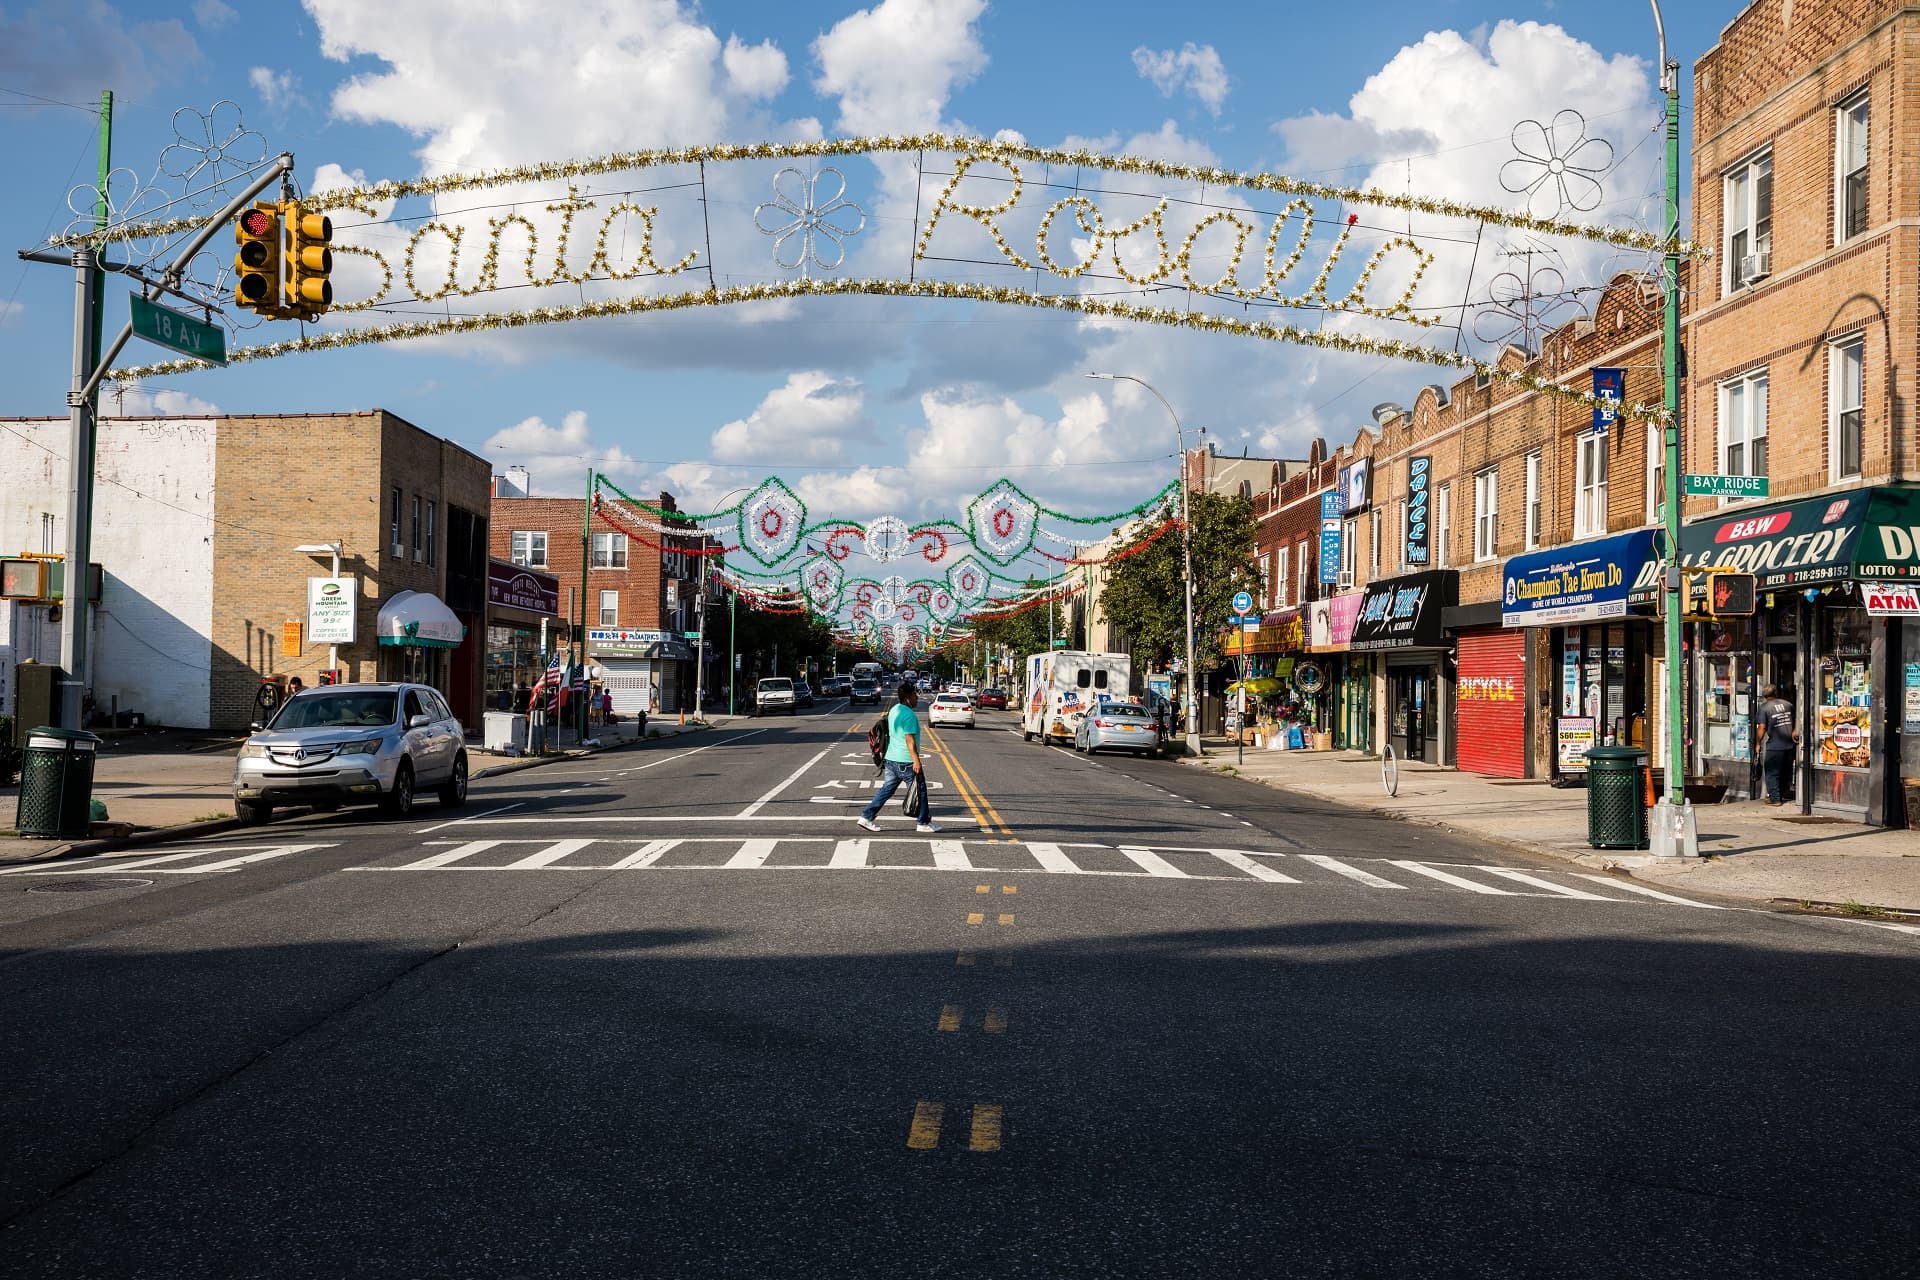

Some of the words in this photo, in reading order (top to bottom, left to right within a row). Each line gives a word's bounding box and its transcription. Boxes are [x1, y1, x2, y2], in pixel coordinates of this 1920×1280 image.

[914, 153, 1442, 327] Rosalia
[155, 312, 172, 338] 18
[1693, 476, 1719, 488] BAY
[1724, 478, 1760, 489] RIDGE
[1711, 488, 1742, 496] PARKWAY
[1325, 495, 1339, 503] MY
[1408, 459, 1428, 540] DANCE
[1730, 516, 1776, 540] B&W
[1713, 525, 1856, 574] GROCERY
[1517, 576, 1560, 600] Champion's
[1562, 571, 1579, 593] Tae
[1580, 568, 1605, 591] Kwon
[1608, 563, 1622, 587] Do
[1766, 574, 1786, 585] BEER
[1794, 565, 1849, 581] 718-259-8152
[1860, 565, 1896, 576] LOTTO
[1545, 599, 1551, 607] OF
[1551, 597, 1566, 606] WORLD
[1567, 593, 1593, 604] CHAMPIONS
[1869, 595, 1919, 609] ATM
[1459, 676, 1514, 701] BICYCLE
